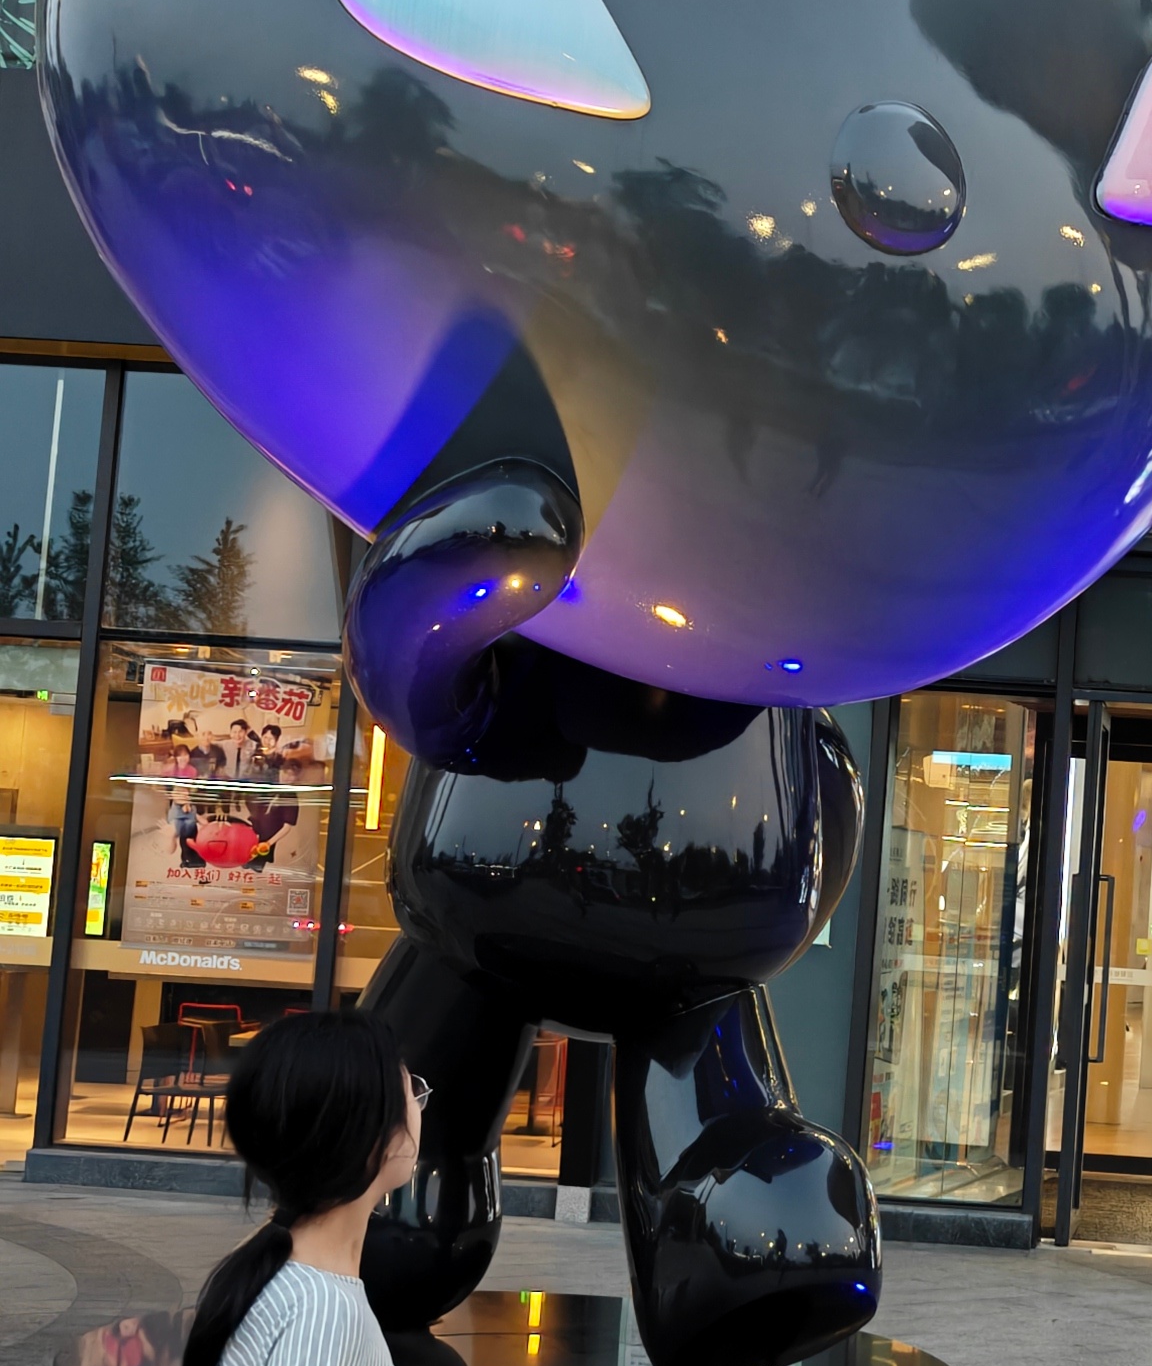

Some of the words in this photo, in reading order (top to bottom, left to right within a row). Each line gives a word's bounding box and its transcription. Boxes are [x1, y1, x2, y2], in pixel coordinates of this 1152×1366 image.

[166, 867, 221, 883] 加入我们
[139, 950, 243, 971] McDonald's
